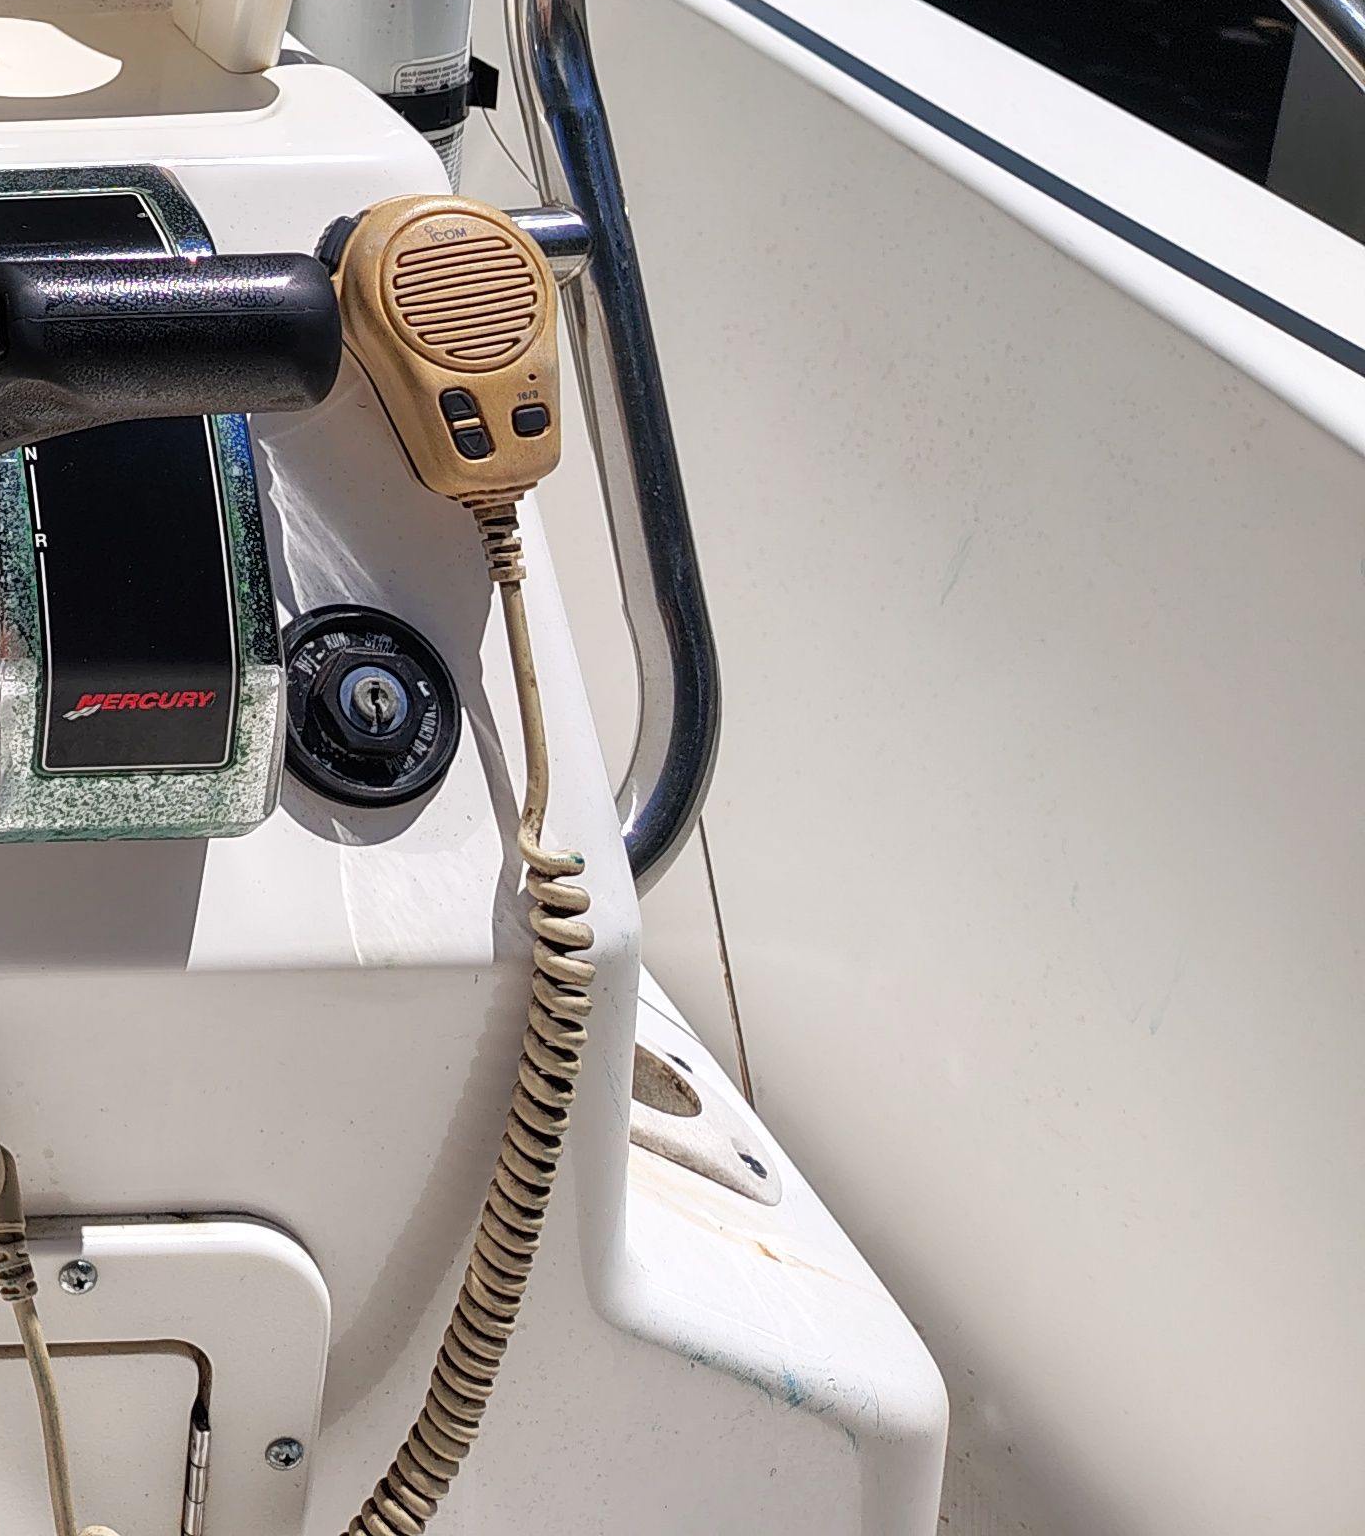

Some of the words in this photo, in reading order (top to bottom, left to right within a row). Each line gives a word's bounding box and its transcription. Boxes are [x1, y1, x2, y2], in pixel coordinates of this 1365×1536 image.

[516, 391, 539, 401] 16/9
[24, 447, 38, 461] N
[34, 534, 48, 548] R
[76, 692, 214, 711] MERCURY
